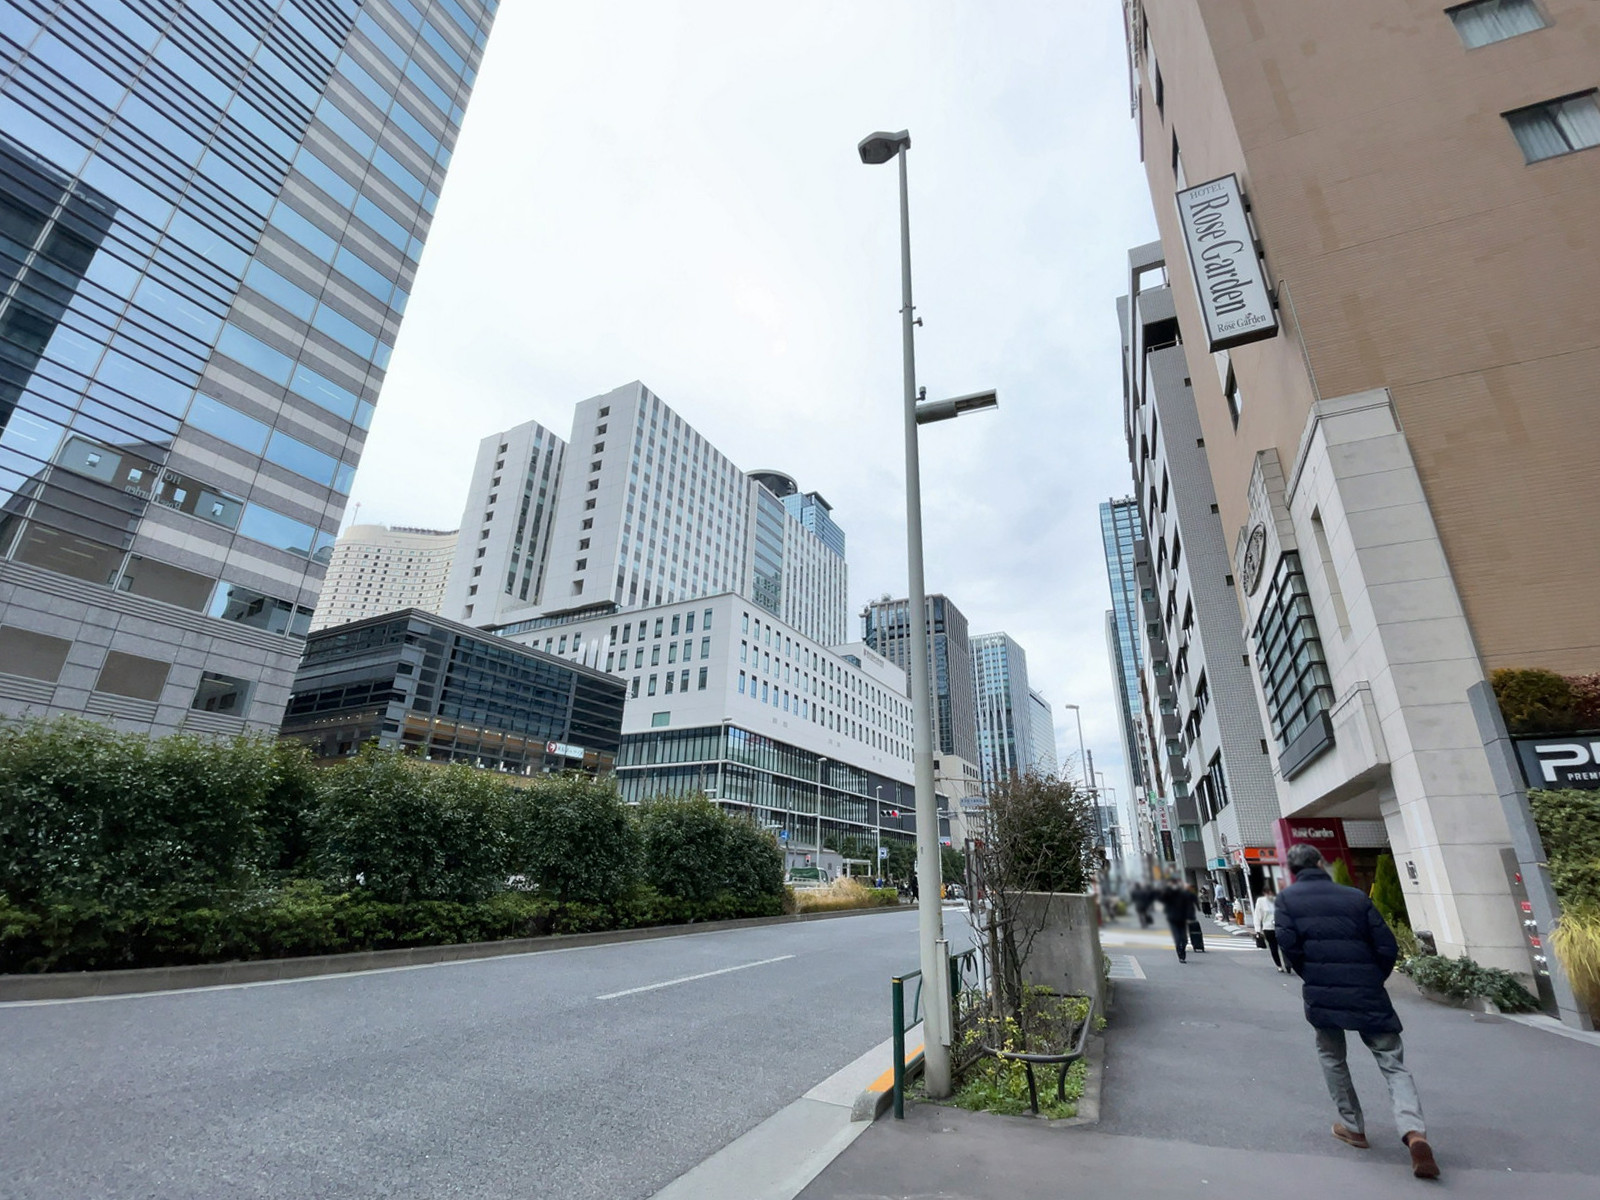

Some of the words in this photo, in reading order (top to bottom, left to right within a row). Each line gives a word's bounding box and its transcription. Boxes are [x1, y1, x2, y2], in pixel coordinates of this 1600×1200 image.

[1189, 183, 1225, 200] HOTEL
[1201, 239, 1253, 317] Garden
[1217, 322, 1236, 333] Rose
[1236, 314, 1267, 328] Garden
[1534, 741, 1600, 783] P
[1308, 827, 1335, 838] Garden
